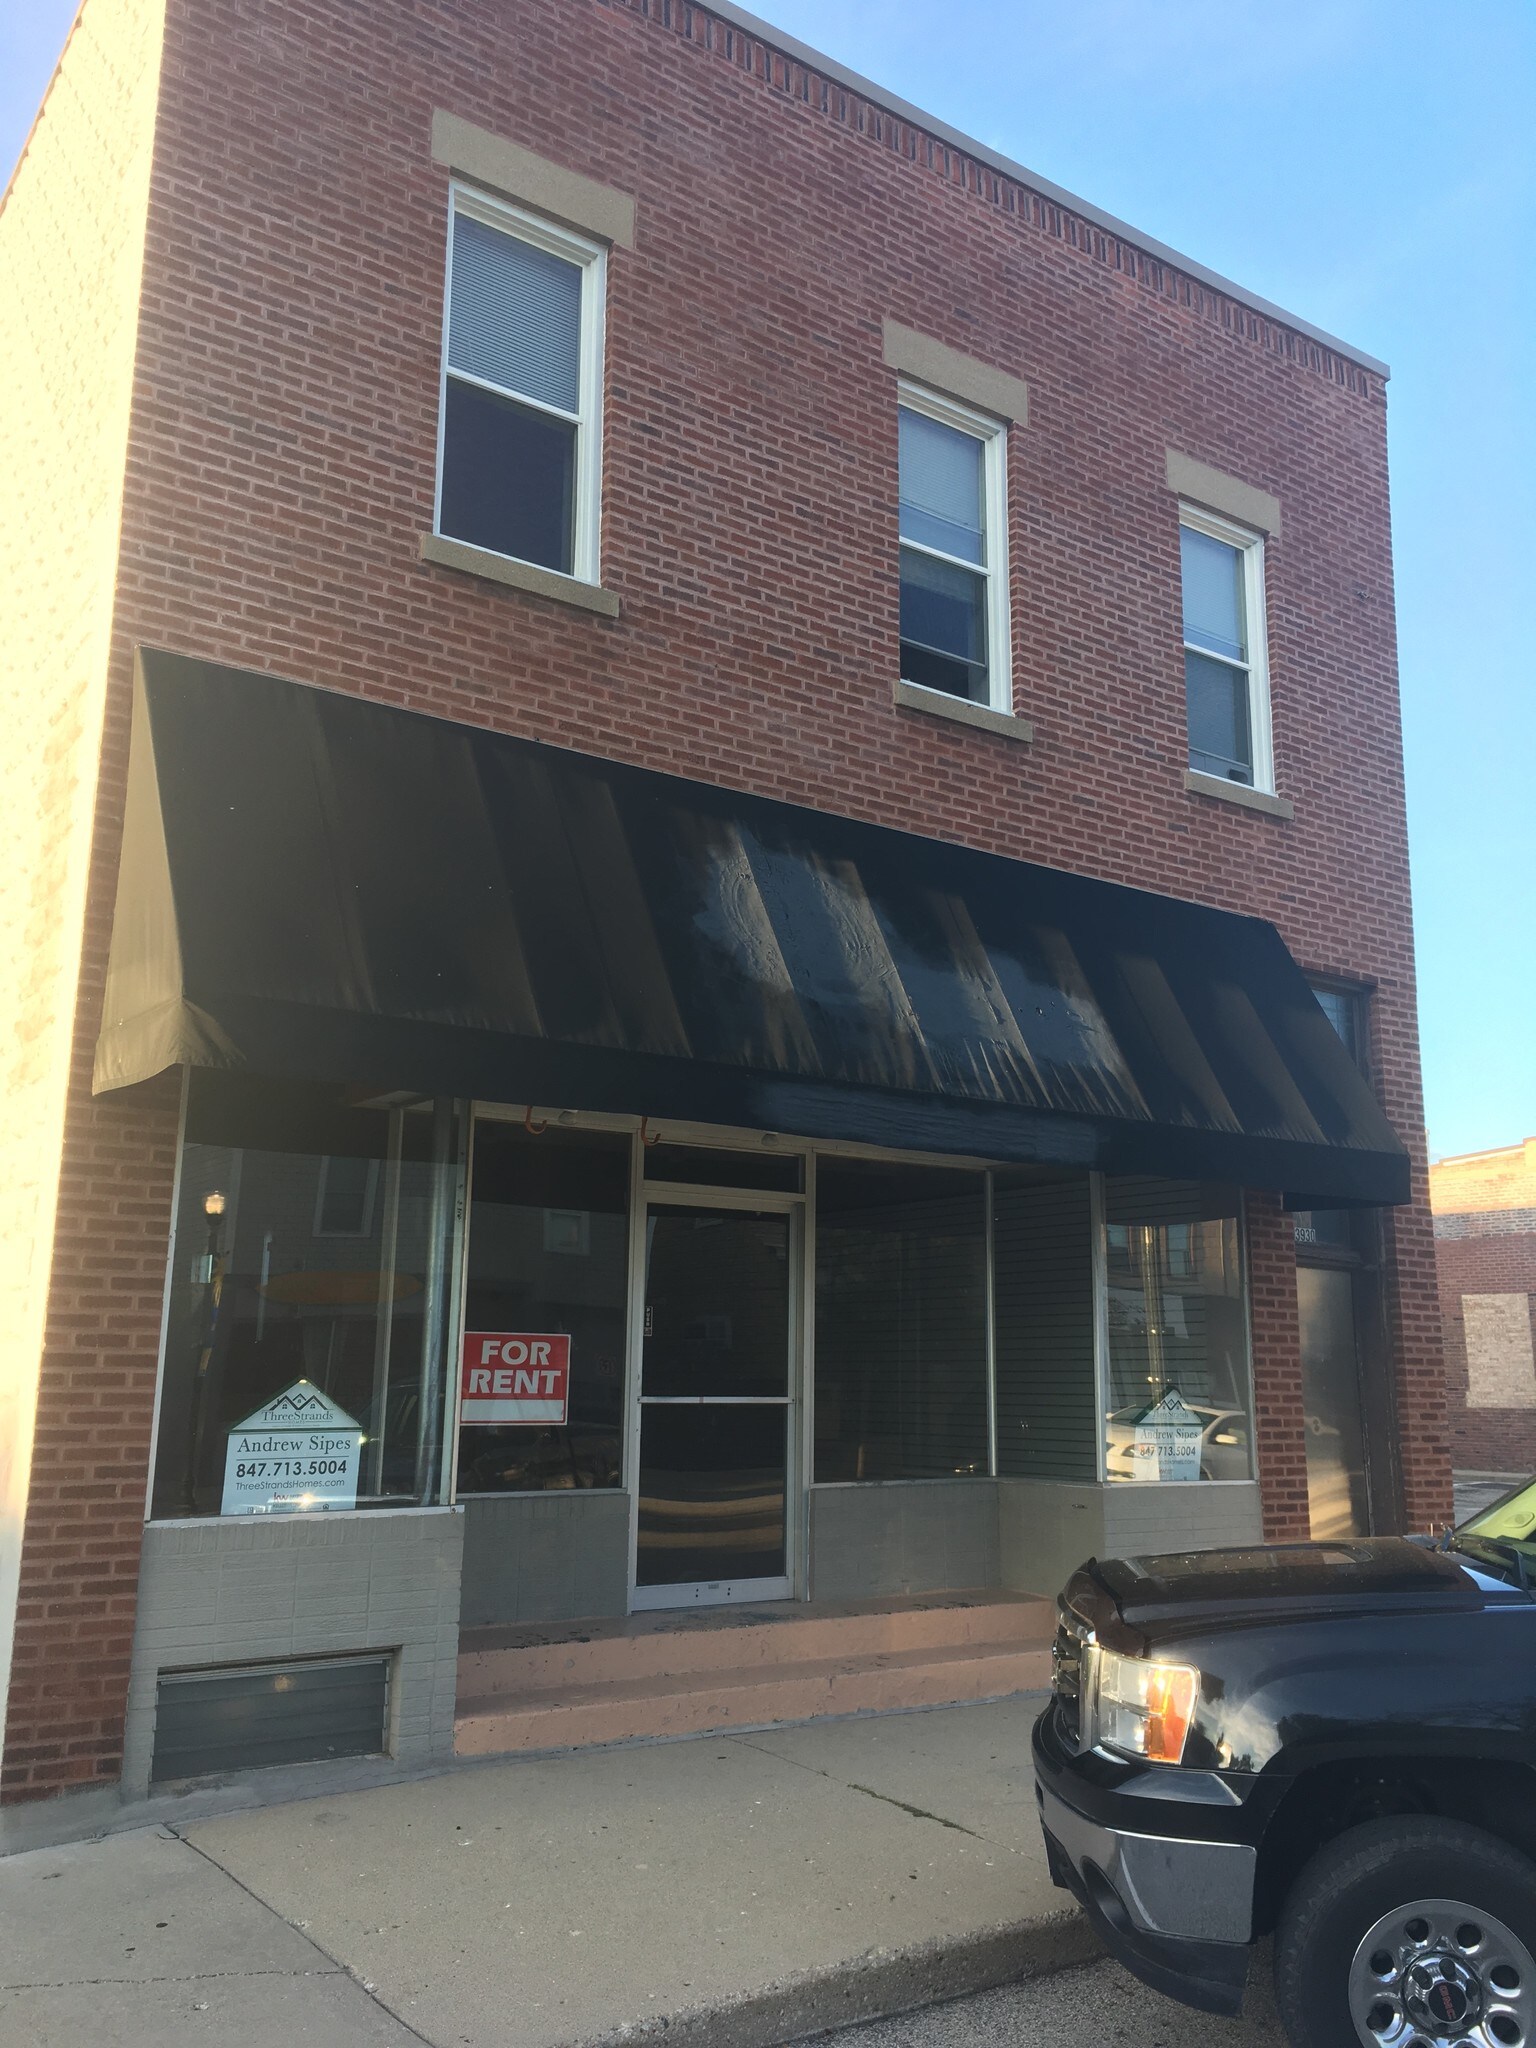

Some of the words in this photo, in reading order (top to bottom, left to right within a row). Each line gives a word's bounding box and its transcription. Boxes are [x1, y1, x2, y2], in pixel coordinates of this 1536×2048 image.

[1295, 1227, 1315, 1242] 3930
[481, 1340, 552, 1365] FOR
[468, 1368, 562, 1394] RENT
[260, 1410, 334, 1421] ThreeStrands
[1141, 1428, 1174, 1439] Andrew
[1175, 1427, 1199, 1442] Sipes
[237, 1436, 303, 1453] Andrew
[308, 1435, 351, 1455] Sipes
[1139, 1446, 1196, 1457] 847713.5004
[236, 1460, 347, 1478] 847.713.5004
[236, 1478, 345, 1491] ThreeStrandsHomes.com
